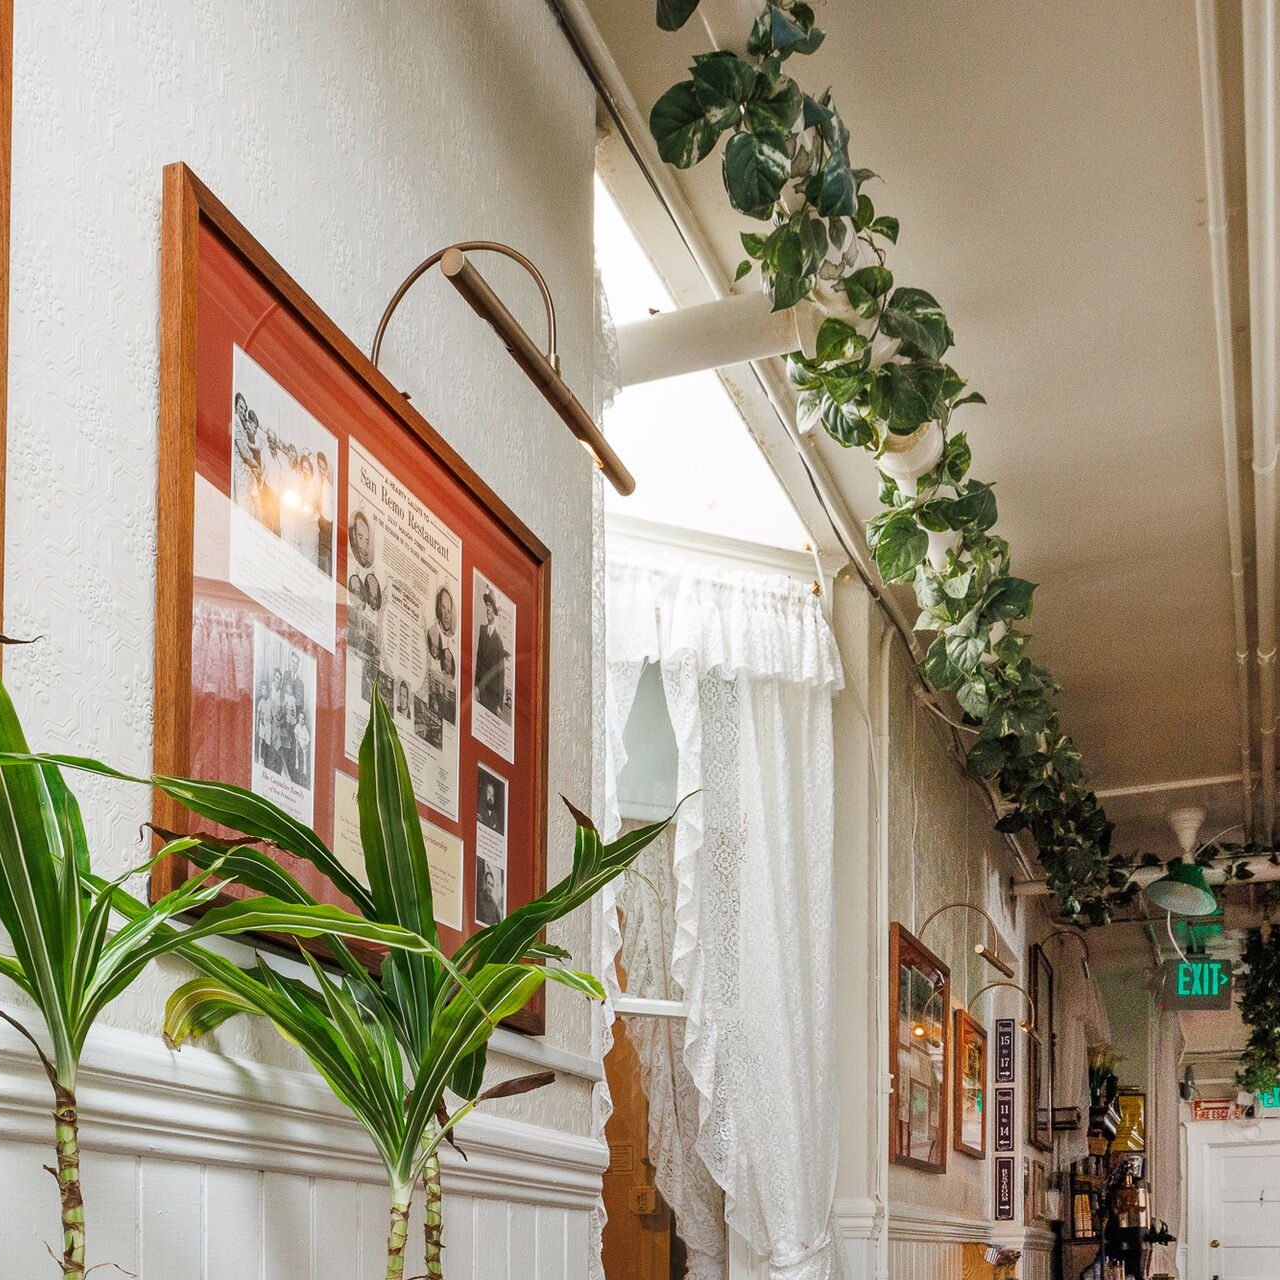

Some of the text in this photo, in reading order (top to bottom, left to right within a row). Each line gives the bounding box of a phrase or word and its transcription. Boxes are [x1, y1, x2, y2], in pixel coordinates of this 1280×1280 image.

[359, 465, 449, 561] San Remo Restaurant
[1178, 963, 1222, 995] EXIT
[1000, 1035, 1010, 1046] 15
[1000, 1057, 1010, 1068] 17
[1000, 1105, 1009, 1114] 11
[1000, 1127, 1009, 1136] 14
[1001, 1168, 1009, 1202] RESTROOM
